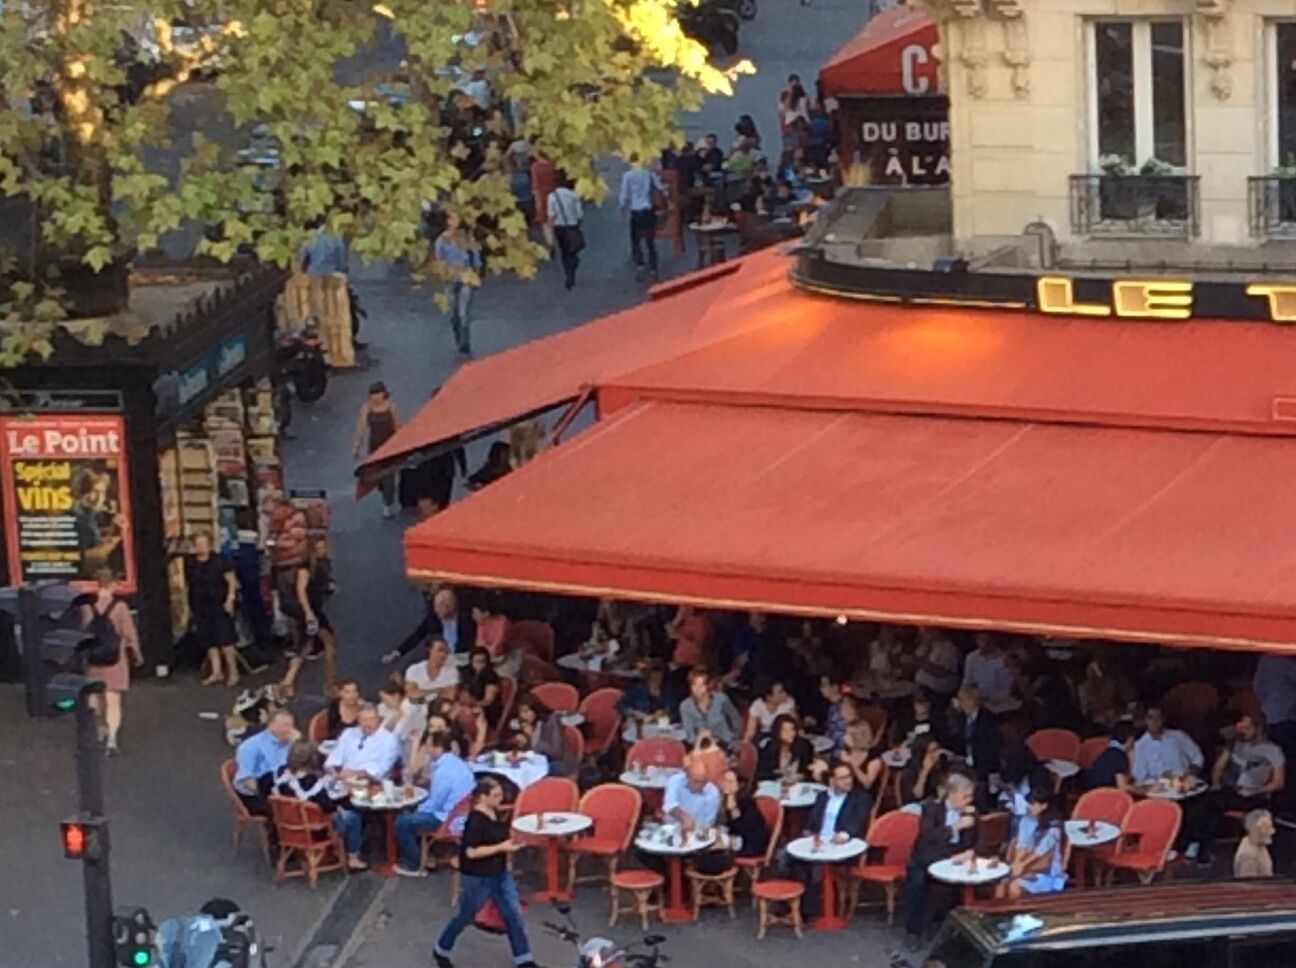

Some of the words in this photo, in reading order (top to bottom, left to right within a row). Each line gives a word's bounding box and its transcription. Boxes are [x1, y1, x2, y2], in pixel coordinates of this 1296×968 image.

[862, 122, 897, 142] DU
[1037, 276, 1193, 318] LE
[7, 430, 40, 455] Le
[44, 427, 120, 453] Point
[17, 480, 73, 511] vins
